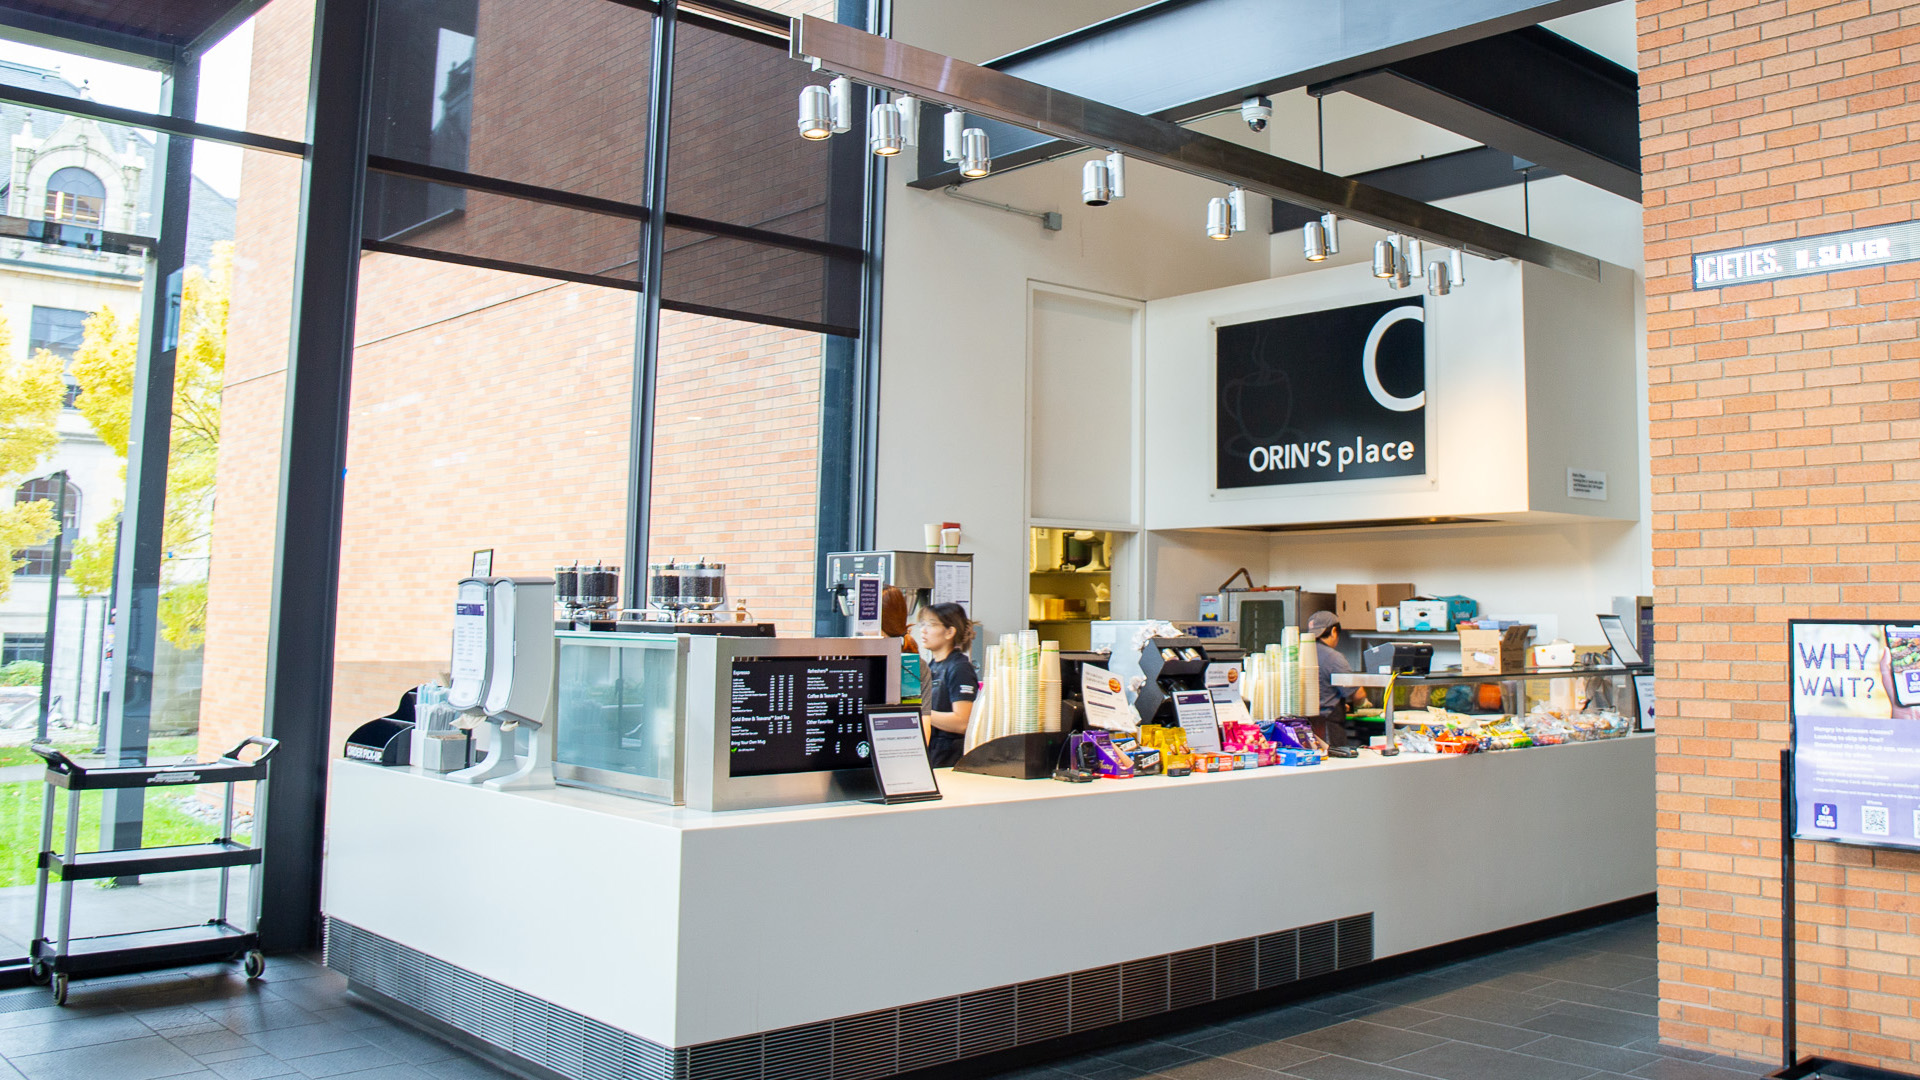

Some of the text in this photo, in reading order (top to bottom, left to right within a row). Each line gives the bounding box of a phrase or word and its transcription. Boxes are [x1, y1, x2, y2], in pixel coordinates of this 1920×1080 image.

[1249, 435, 1415, 473] ORIN'S place
[1798, 642, 1872, 671] WHY
[1799, 675, 1876, 699] WAIT?
